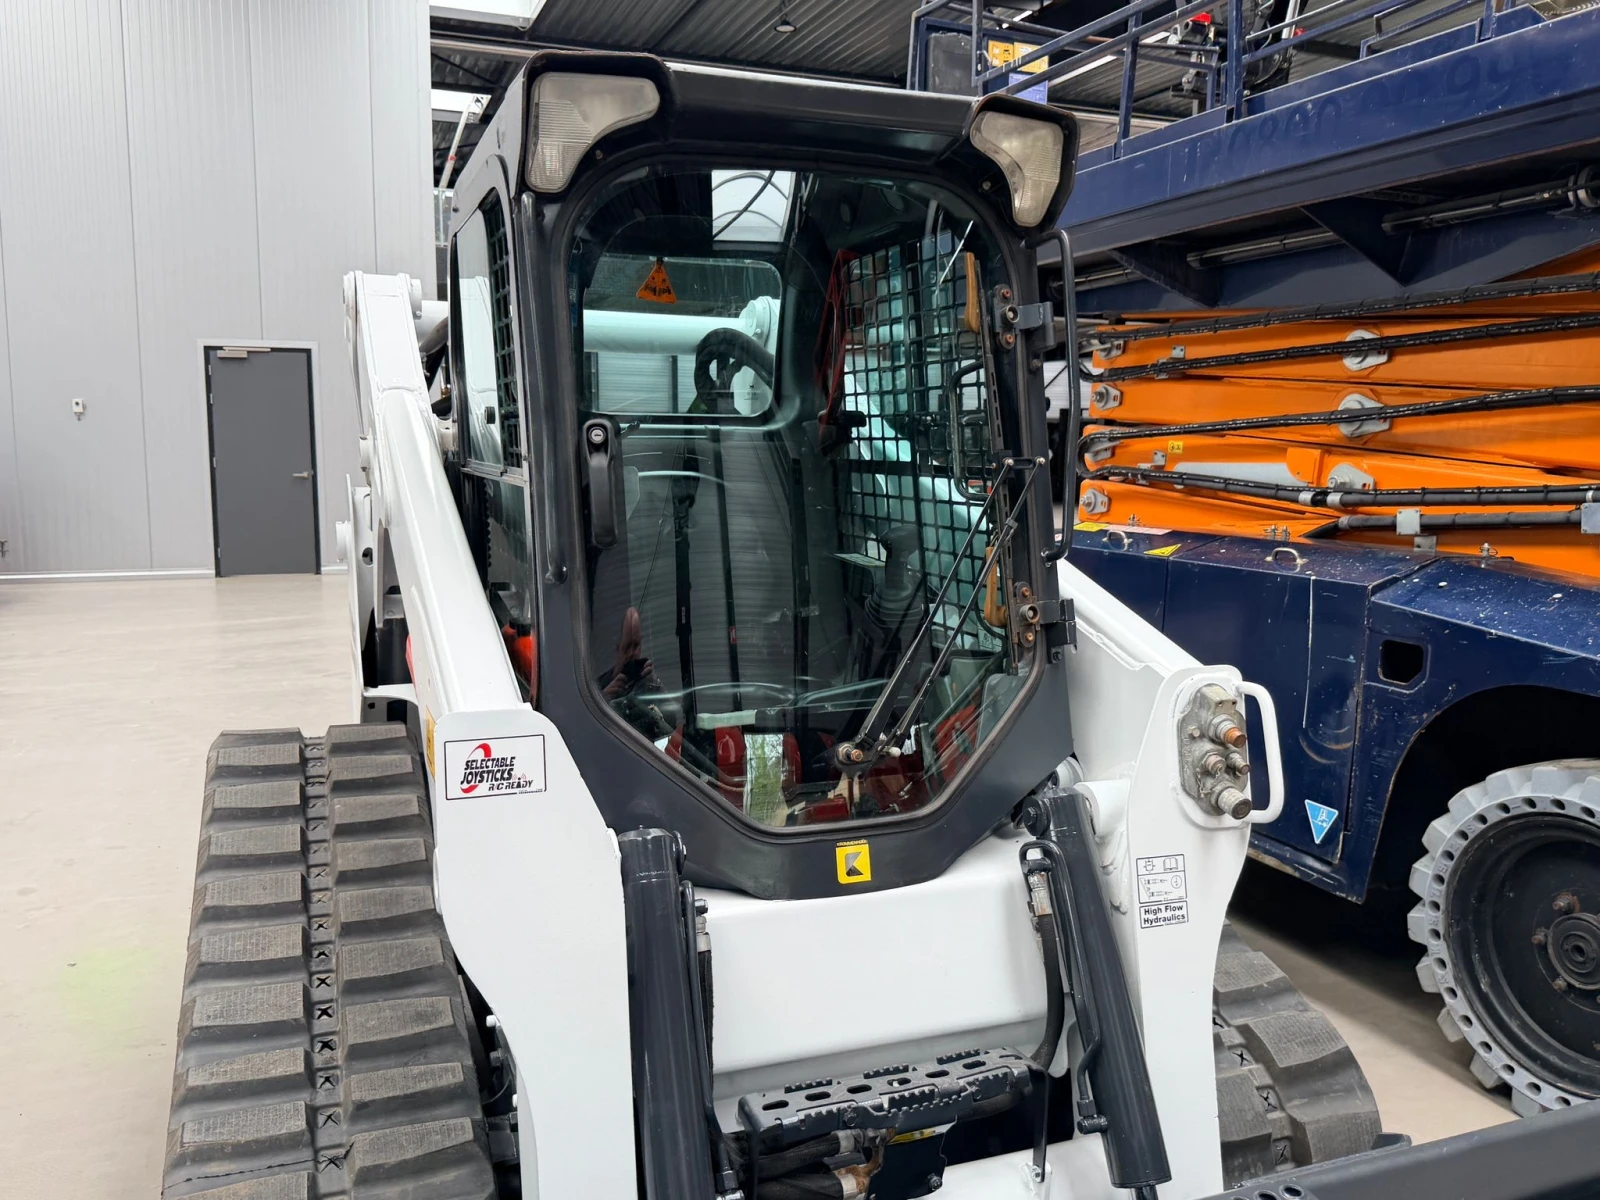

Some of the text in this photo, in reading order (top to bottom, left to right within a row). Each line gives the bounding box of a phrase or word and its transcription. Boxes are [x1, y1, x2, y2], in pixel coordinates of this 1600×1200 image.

[464, 756, 516, 771] SELECTABLE
[460, 767, 514, 785] JOYSTICKS
[1144, 904, 1183, 916] High Flow
[1143, 914, 1186, 925] Hydraulics
